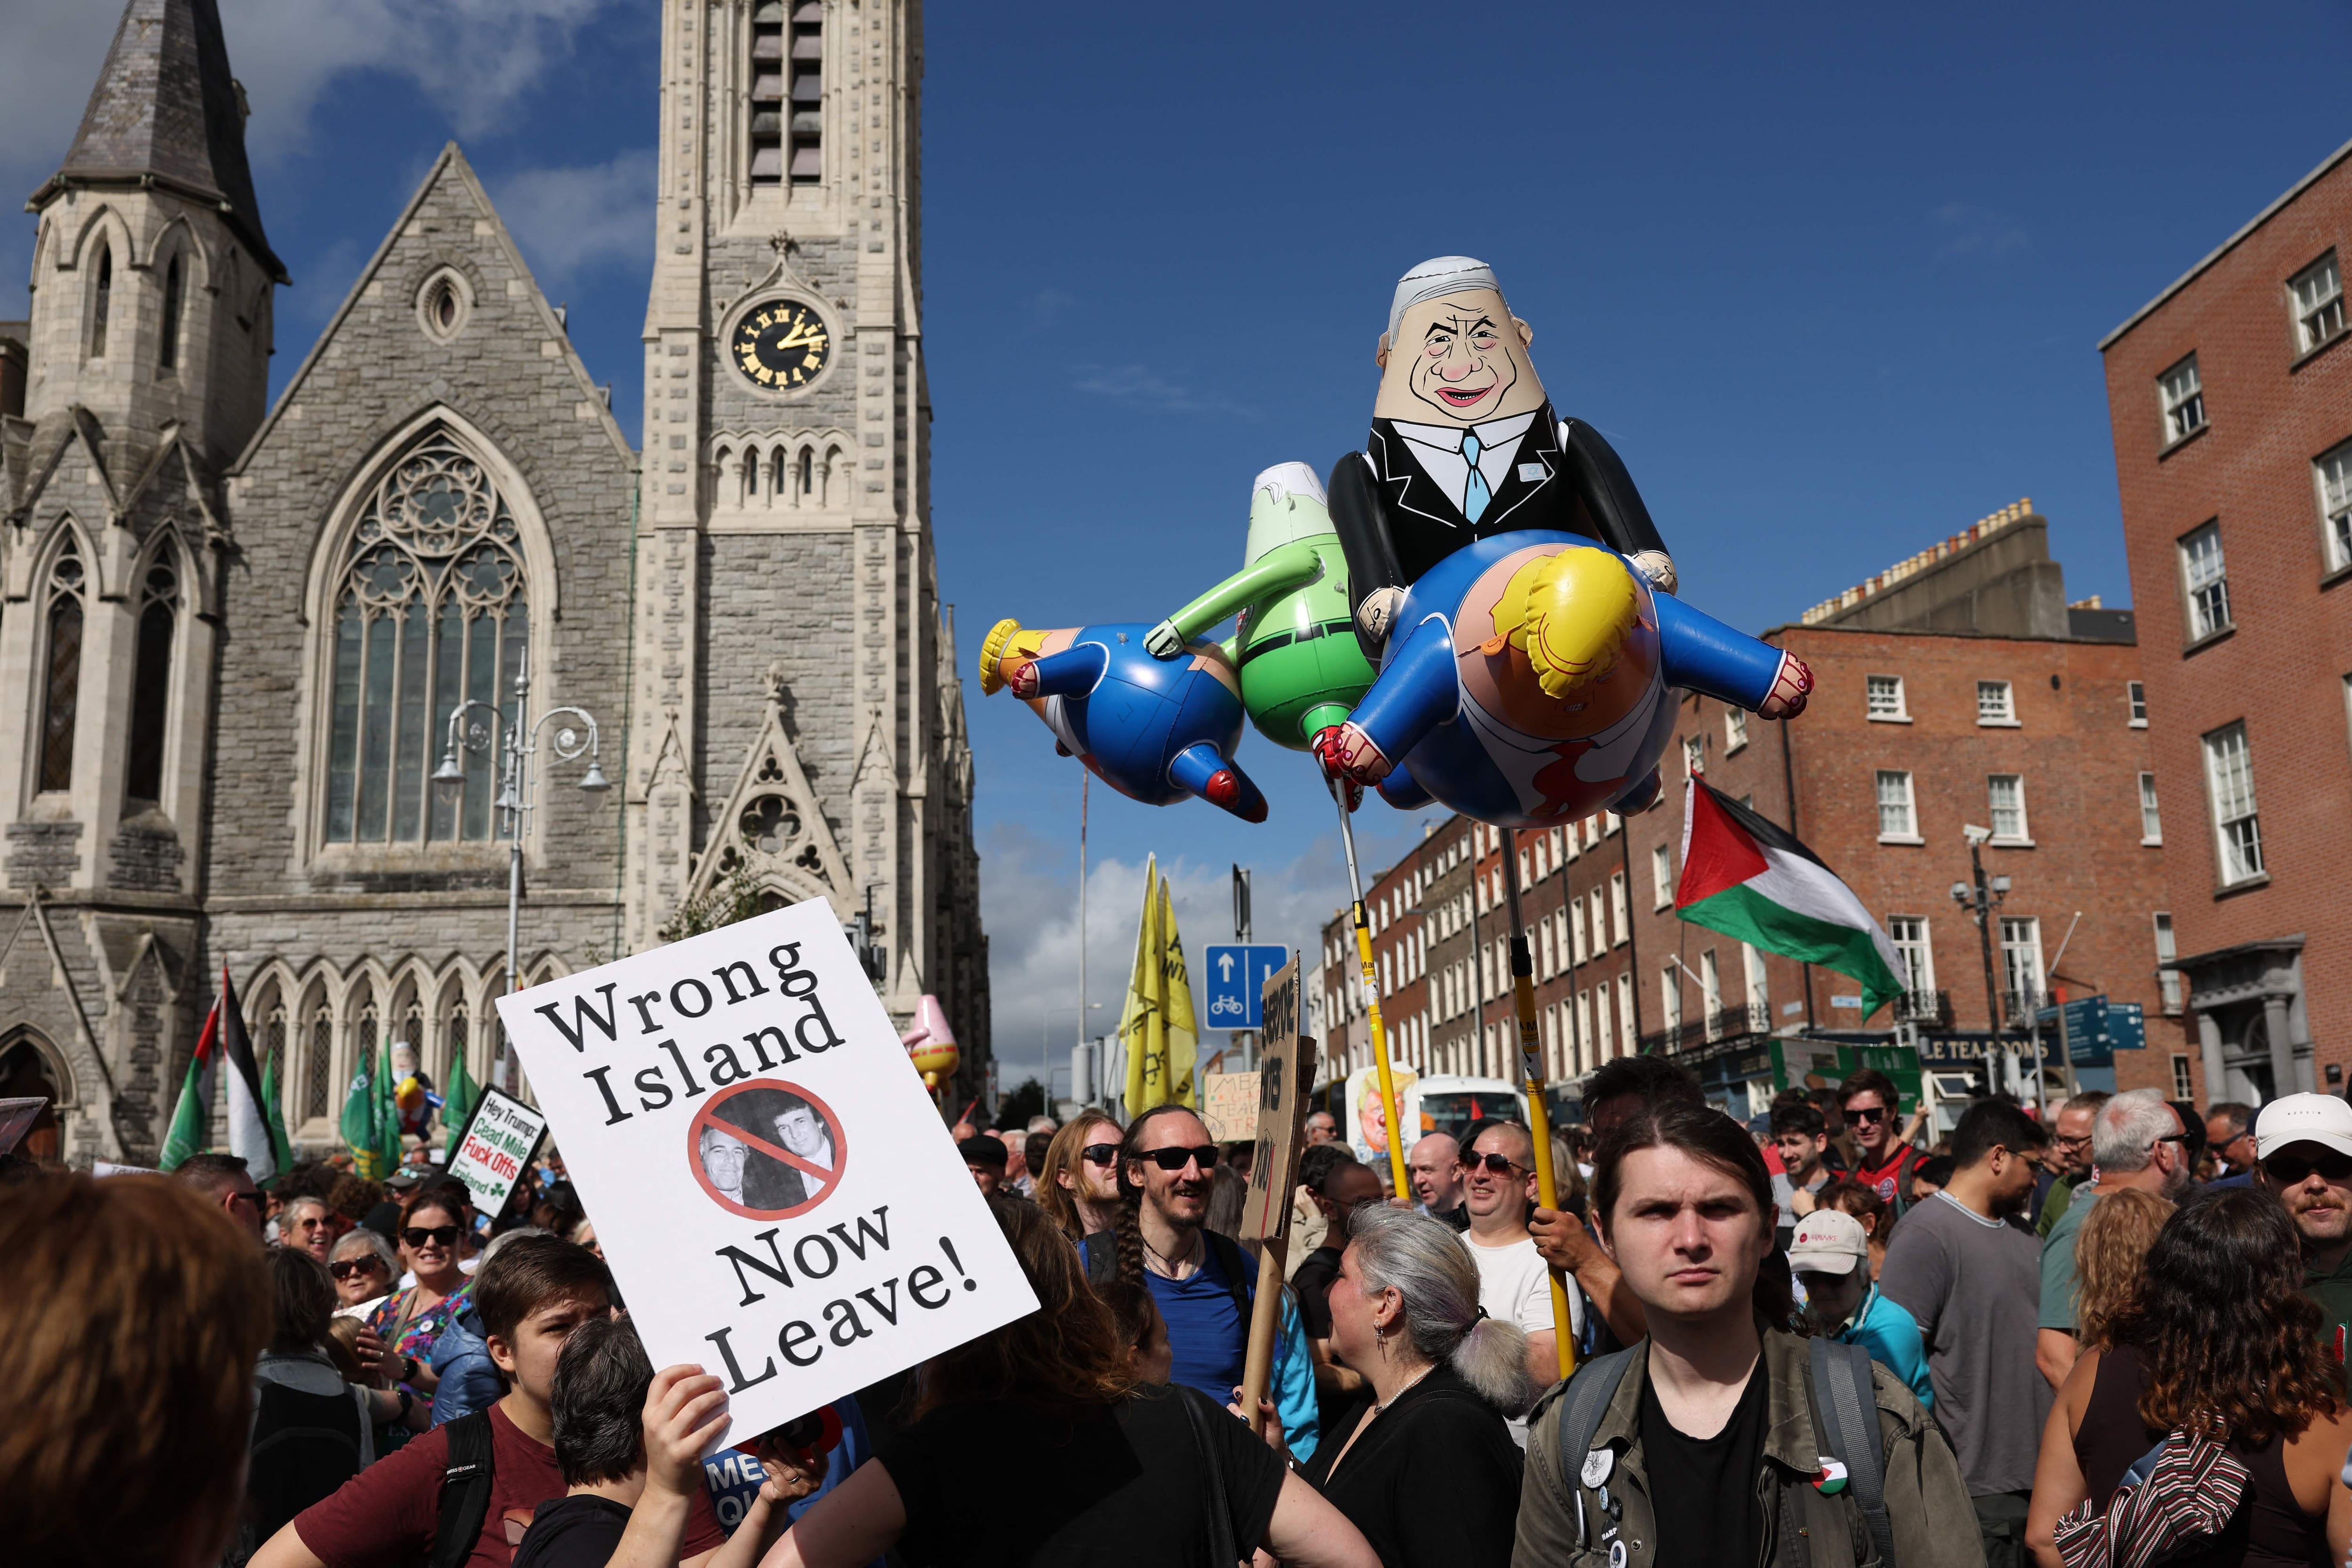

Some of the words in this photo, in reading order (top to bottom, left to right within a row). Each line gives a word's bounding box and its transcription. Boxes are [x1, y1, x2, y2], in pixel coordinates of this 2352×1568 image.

[534, 942, 818, 1052] Wrong
[583, 993, 846, 1126] Island
[1947, 1041, 1983, 1059] TEA
[484, 1097, 505, 1121] Hey
[462, 1135, 493, 1167] Fuck
[491, 1152, 517, 1180] Offs
[501, 1134, 527, 1161] Mile
[715, 1205, 890, 1307] Now
[705, 1236, 977, 1395] Leave!
[1588, 1475, 1603, 1487] BILE
[1601, 1527, 1618, 1541] HARP
